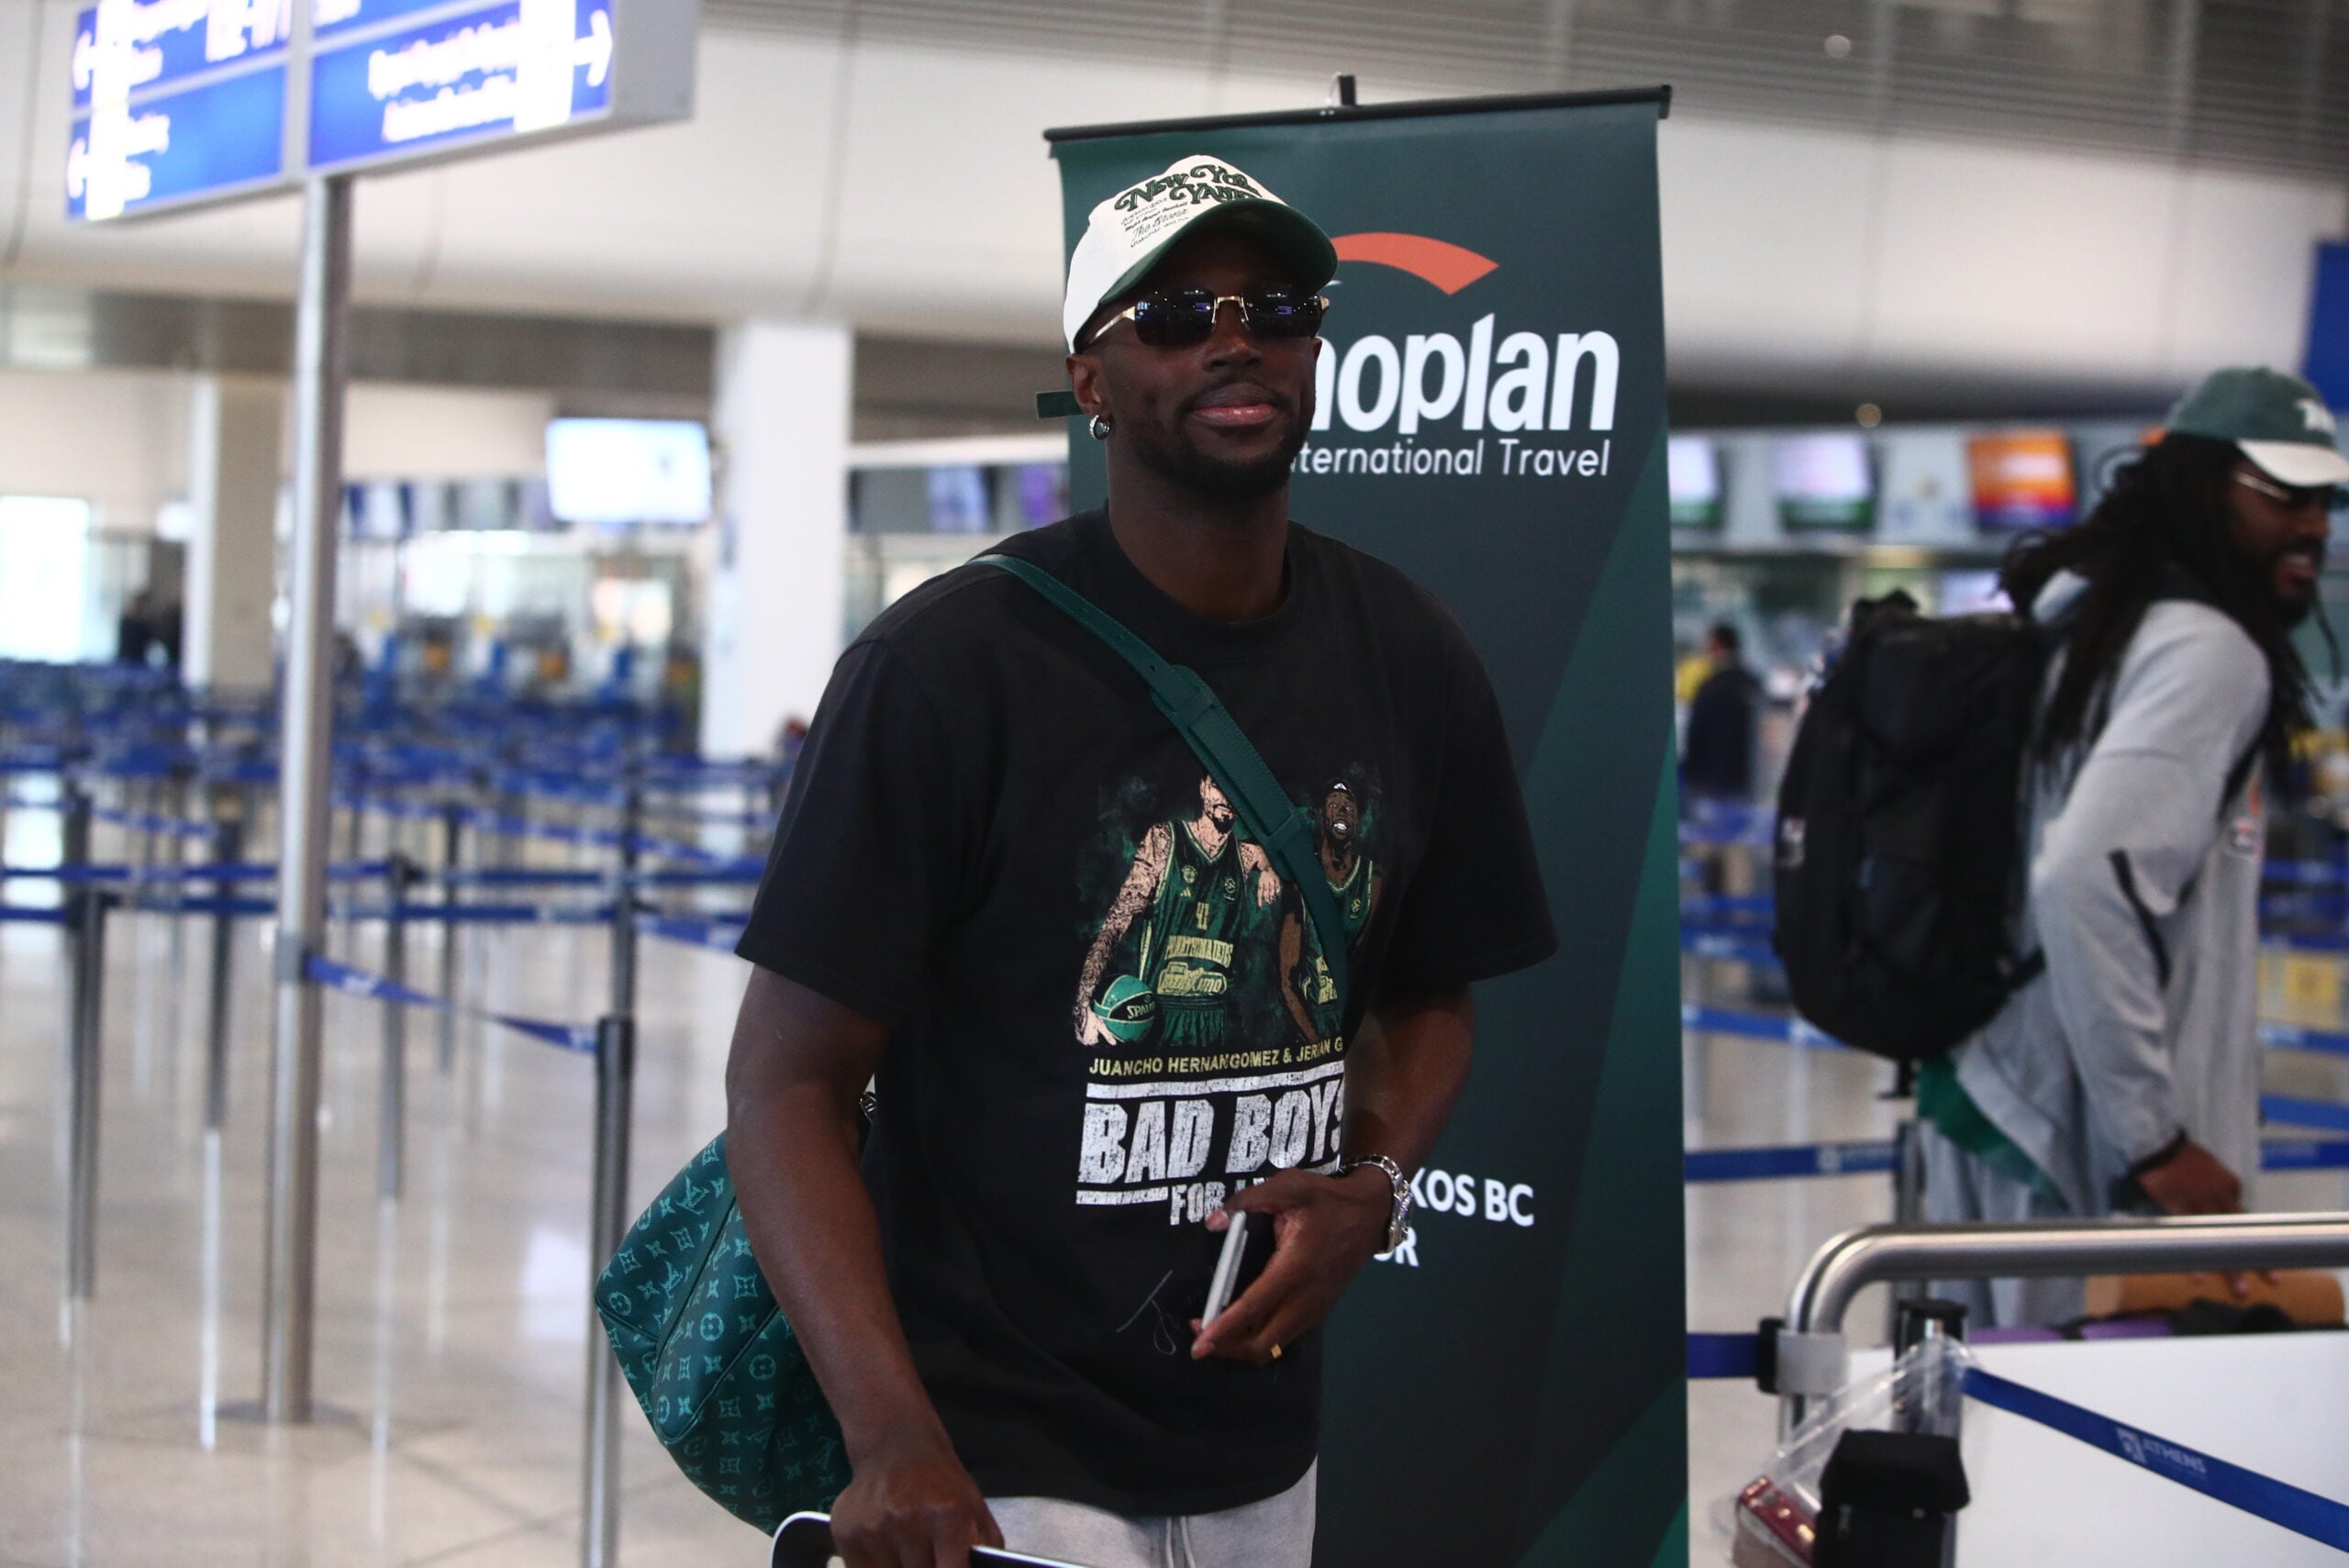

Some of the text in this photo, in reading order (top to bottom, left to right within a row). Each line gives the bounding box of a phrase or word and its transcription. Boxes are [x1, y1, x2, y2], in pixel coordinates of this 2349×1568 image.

[1498, 439, 1611, 476] Travel
[1089, 1056, 1163, 1076] JUANCHO
[1283, 1048, 1293, 1063] &
[1077, 1099, 1215, 1184] BAD
[1170, 1180, 1226, 1226] FOR
[1484, 1178, 1535, 1228] BC
